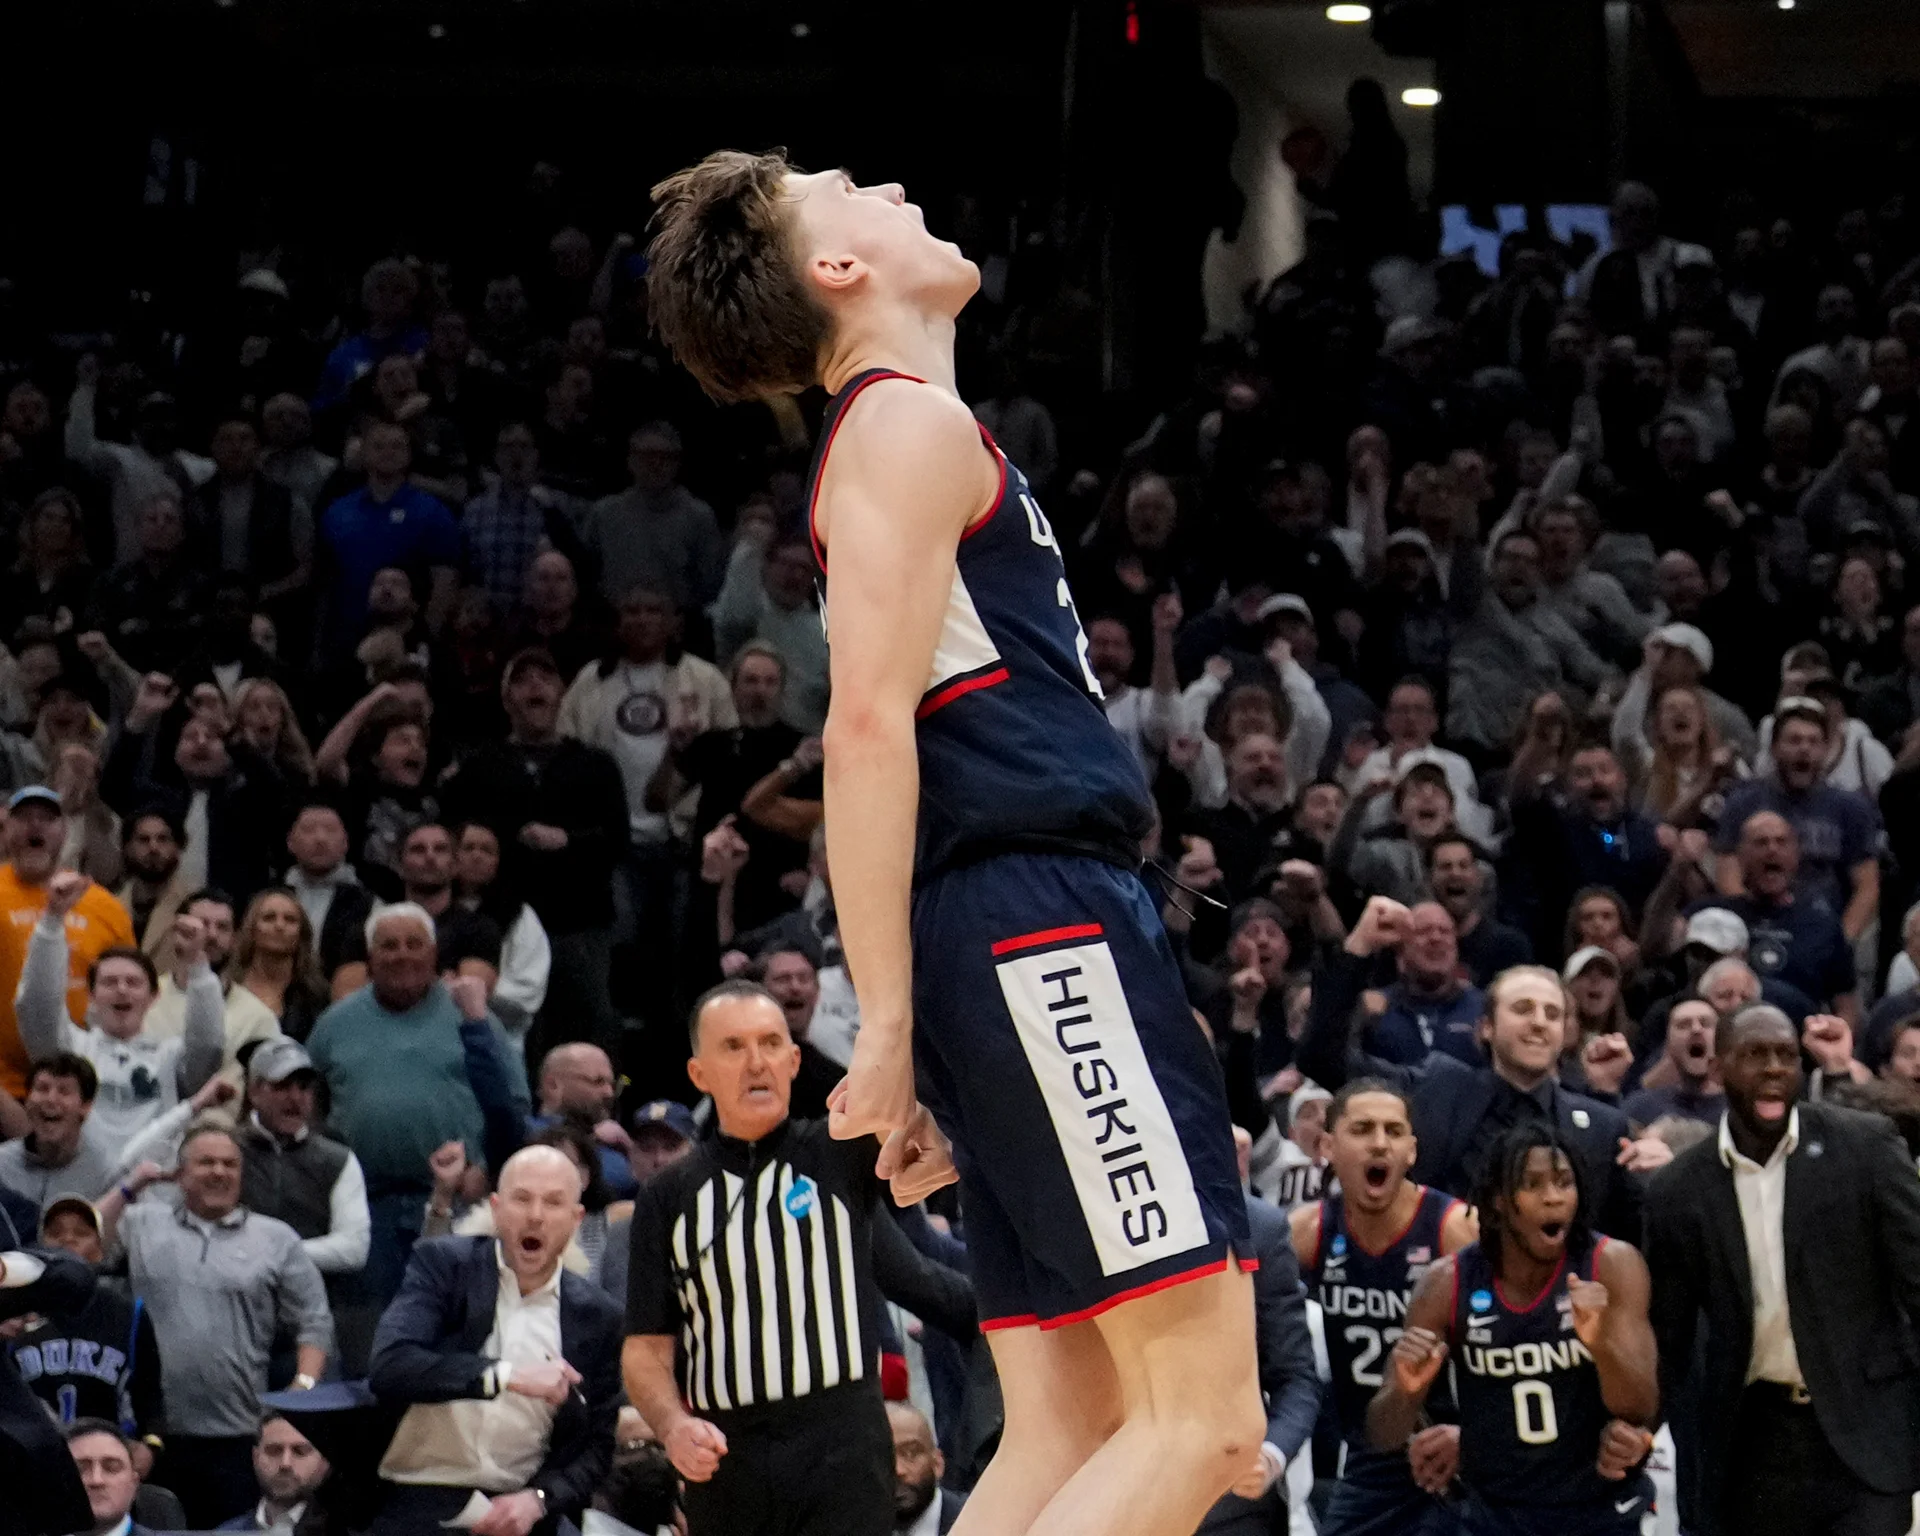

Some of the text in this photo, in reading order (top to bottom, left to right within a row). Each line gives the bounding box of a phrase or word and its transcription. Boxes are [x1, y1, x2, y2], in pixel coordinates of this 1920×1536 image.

[1041, 966, 1168, 1247] HUSKIES
[1319, 1284, 1414, 1321] UCON
[14, 1337, 127, 1388] DUKE
[1343, 1324, 1405, 1387] 2
[1511, 1379, 1559, 1445] 0
